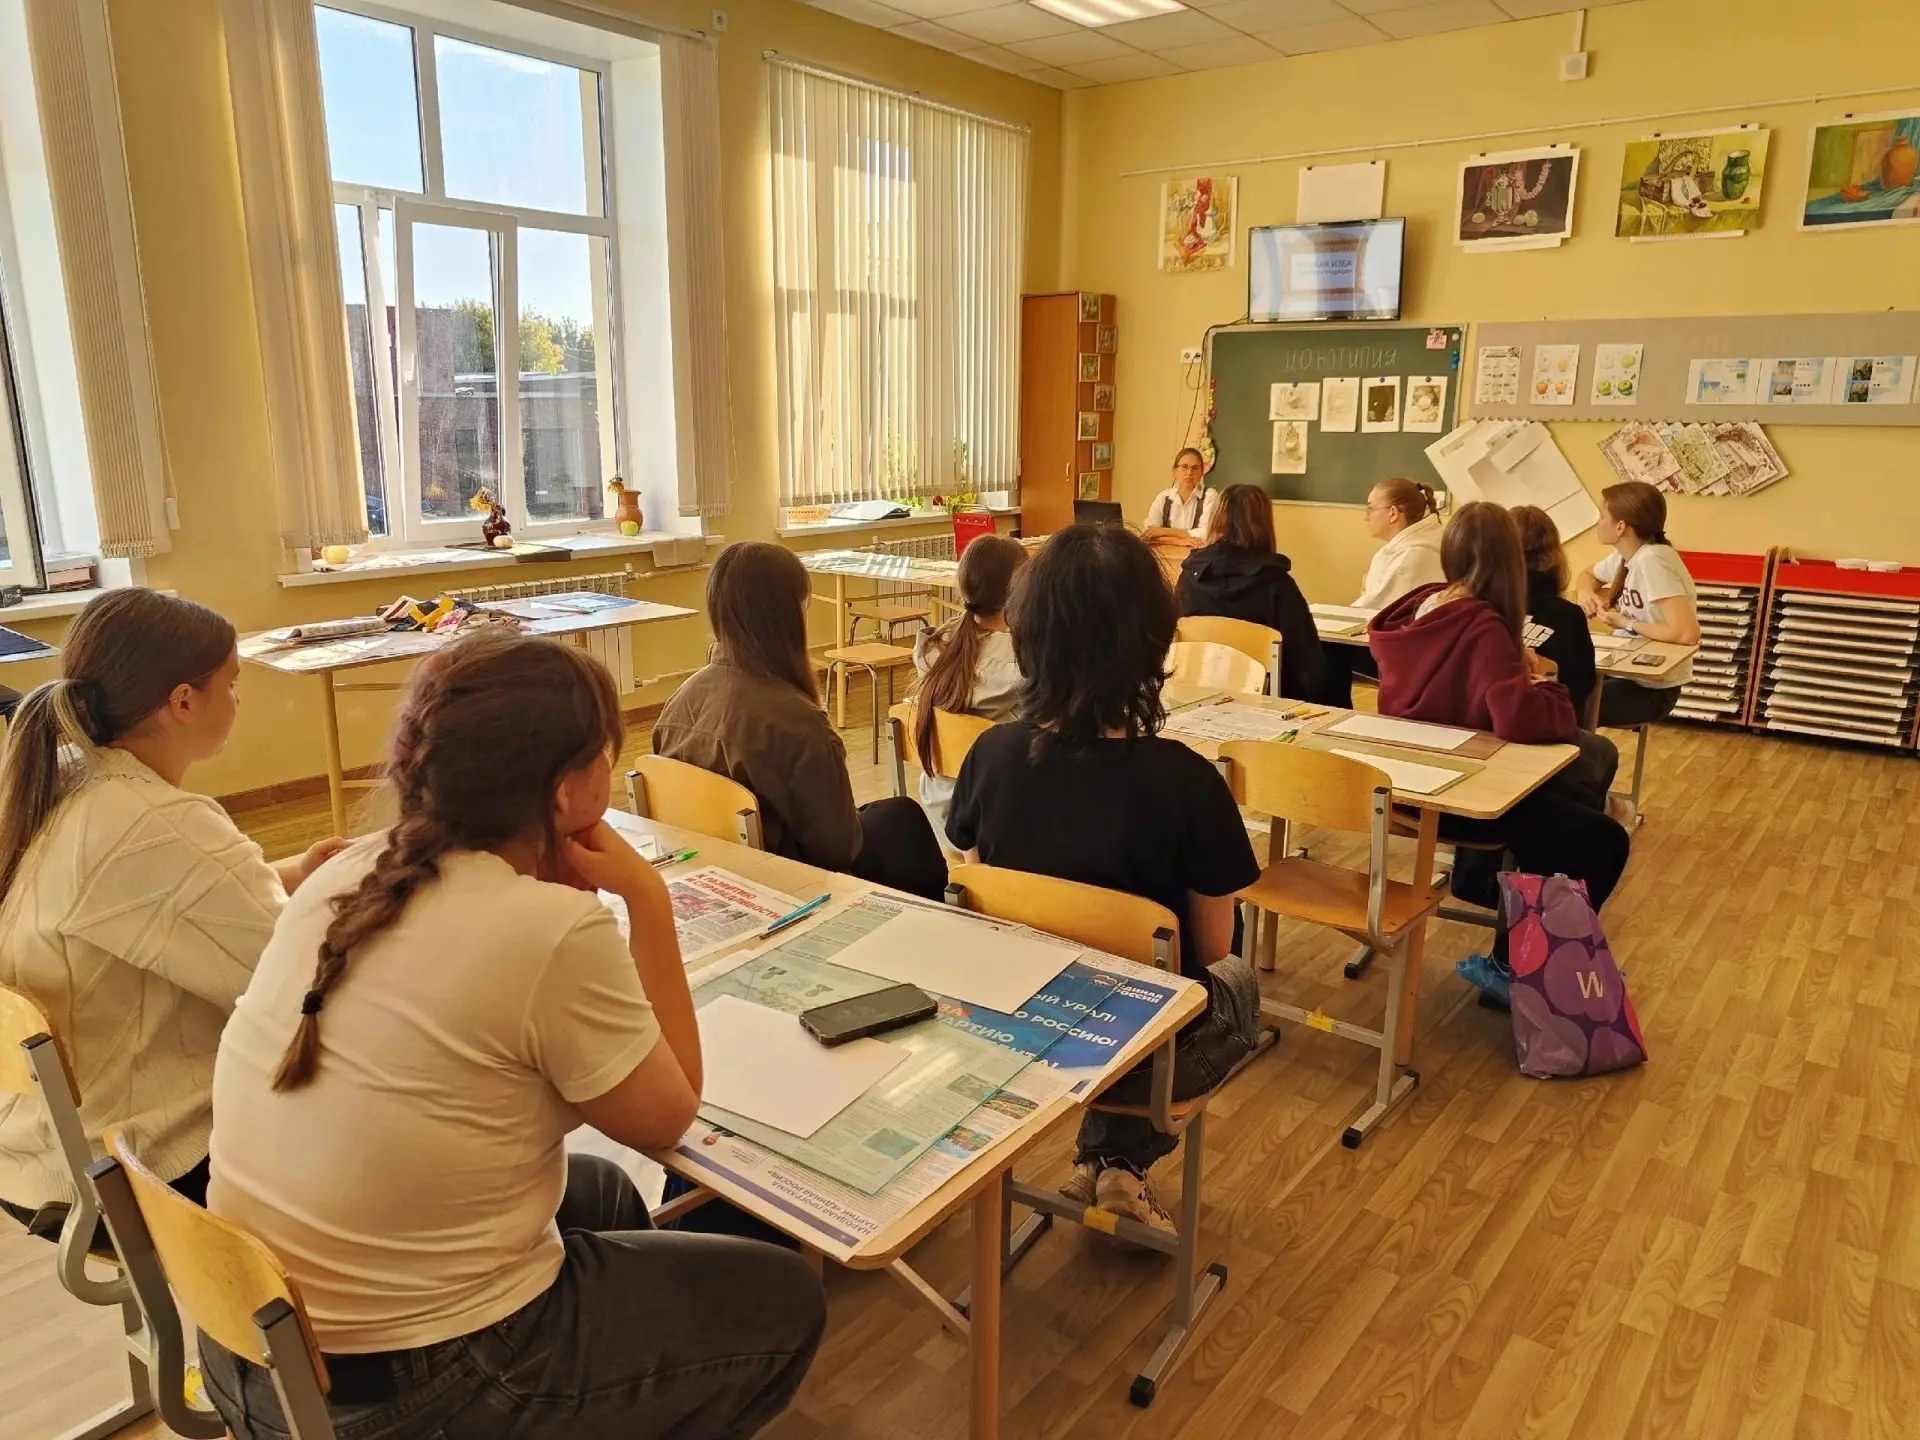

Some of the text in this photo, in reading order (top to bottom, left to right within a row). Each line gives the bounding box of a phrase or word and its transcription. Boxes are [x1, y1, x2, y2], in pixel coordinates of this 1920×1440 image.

[1281, 345, 1397, 372] МОНОТИПИЯ
[1062, 1000, 1117, 1022] УРАЛ!
[935, 1013, 1015, 1043] АРТИЮ
[1030, 1015, 1118, 1047] РОССИЮ!
[772, 1180, 823, 1210] ПРОГРАММА
[822, 1207, 871, 1236] НАРОДНАЯ
